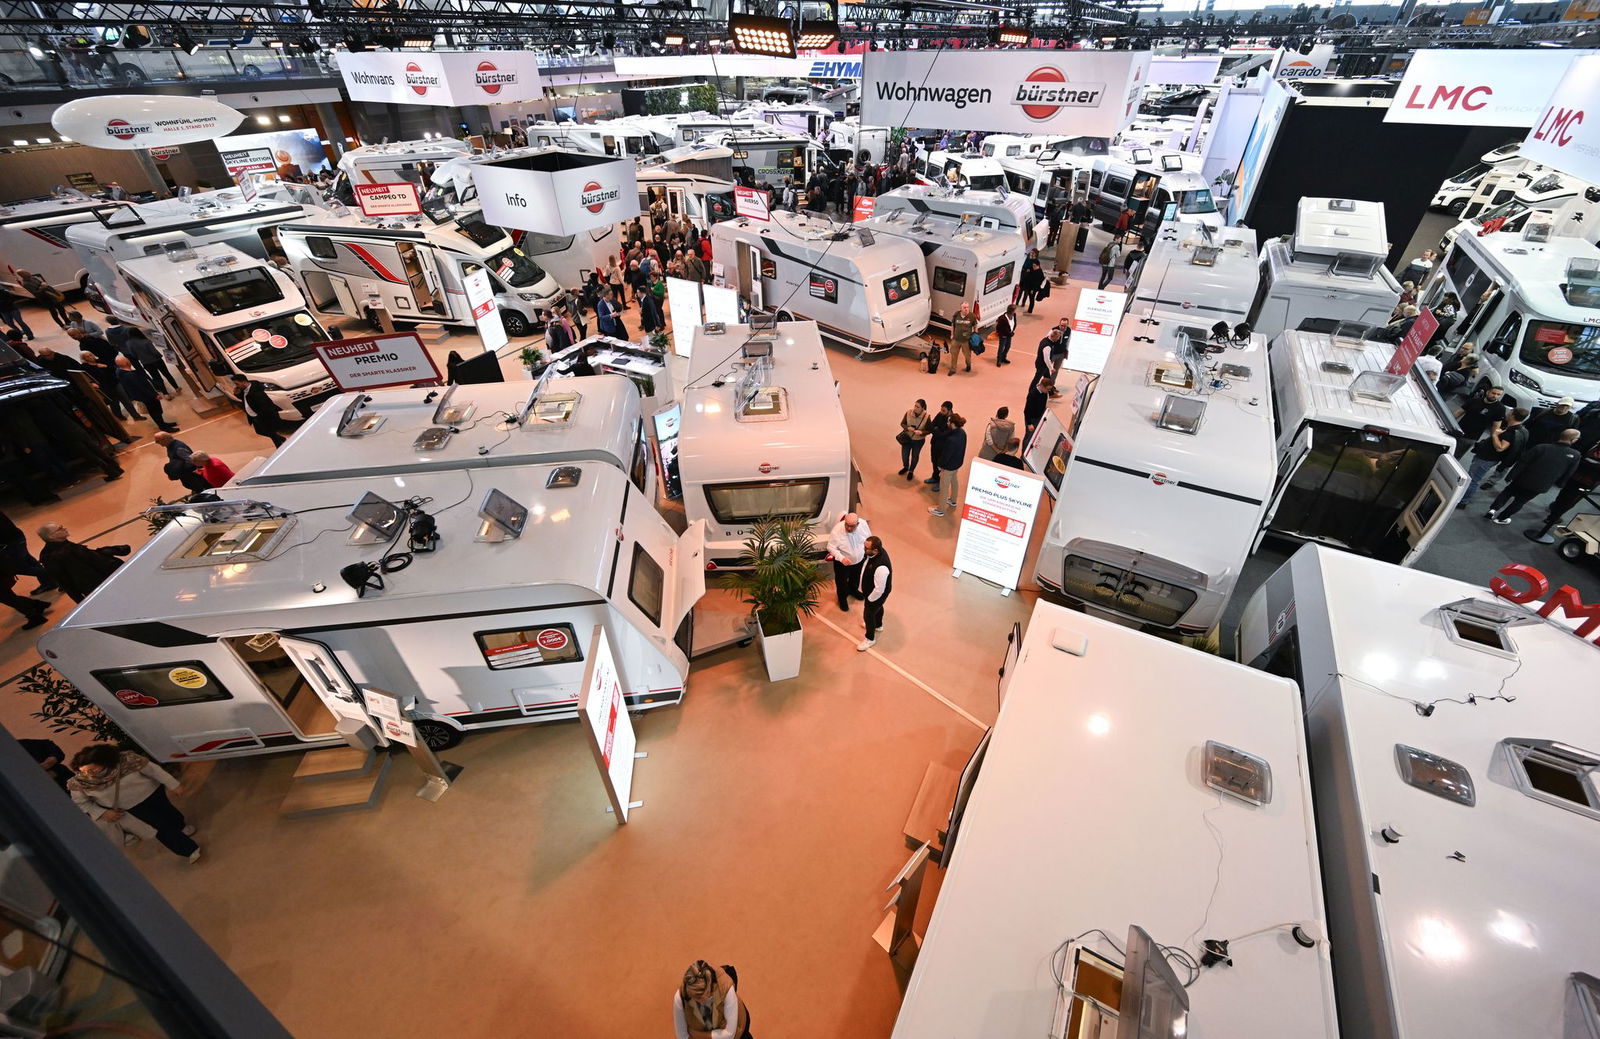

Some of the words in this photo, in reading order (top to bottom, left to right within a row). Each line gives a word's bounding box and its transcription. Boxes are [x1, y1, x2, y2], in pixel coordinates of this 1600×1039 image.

[823, 61, 862, 77] HYM
[1280, 66, 1321, 77] carado
[350, 71, 395, 86] Wohnvans
[405, 73, 438, 86] bürstner
[475, 72, 516, 84] bürstner
[876, 81, 991, 109] Wohnwagen
[1016, 84, 1099, 104] bürstner
[1405, 85, 1493, 111] LMC
[106, 125, 150, 135] bürstner
[1533, 106, 1584, 147] LMC
[151, 147, 179, 156] bürstner
[360, 186, 388, 194] NEUHEIT
[369, 193, 397, 201] CAMPEO
[581, 189, 618, 206] bürstner
[505, 192, 527, 208] Info
[329, 342, 374, 357] NEUHEIT
[354, 352, 399, 365] PREMIO
[385, 366, 417, 374] KLASSIKER
[971, 486, 993, 496] PREMIO
[993, 492, 1008, 501] PLUS
[1008, 497, 1032, 509] SKYLINE
